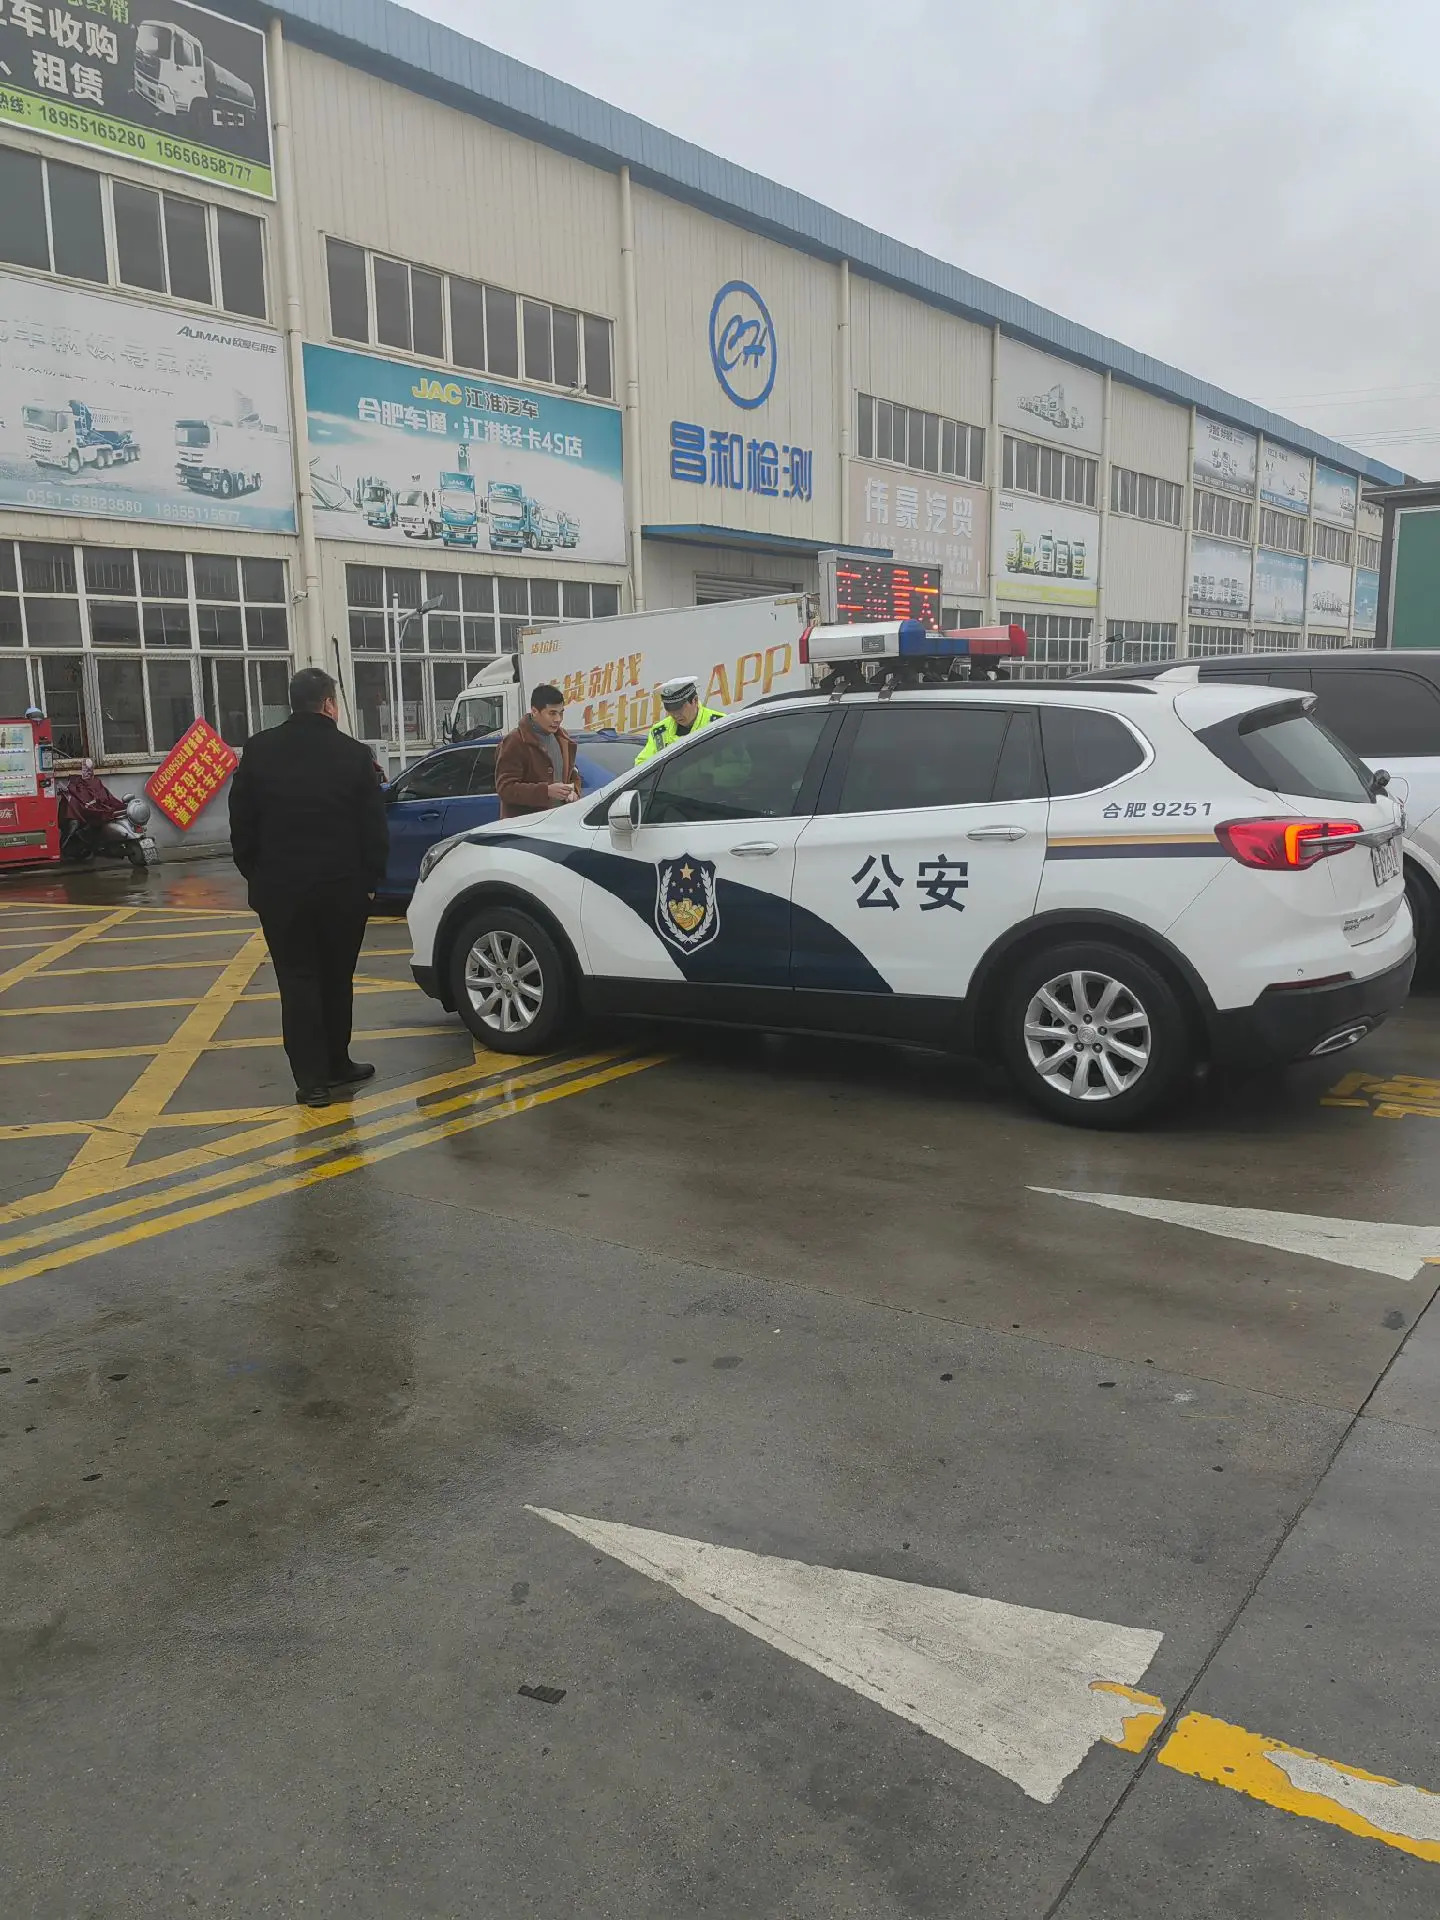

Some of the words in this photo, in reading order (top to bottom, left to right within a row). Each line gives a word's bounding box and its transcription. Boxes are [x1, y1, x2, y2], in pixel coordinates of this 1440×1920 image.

[0, 0, 118, 64] 车收购
[39, 105, 146, 150] 18955165280
[156, 140, 252, 182] 15656858777
[177, 325, 231, 346] AUMAN
[412, 378, 463, 406] JAC
[464, 386, 539, 420] 江淮汽车
[670, 420, 813, 502] 昌和检测
[865, 477, 973, 539] 伟豪汽贸
[538, 652, 643, 707] 货就找
[704, 643, 792, 706] APP
[161, 738, 221, 811] 北斗定位安装
[1102, 802, 1147, 818] 合肥
[1151, 802, 1212, 817] 9251
[851, 853, 969, 912] 公安
